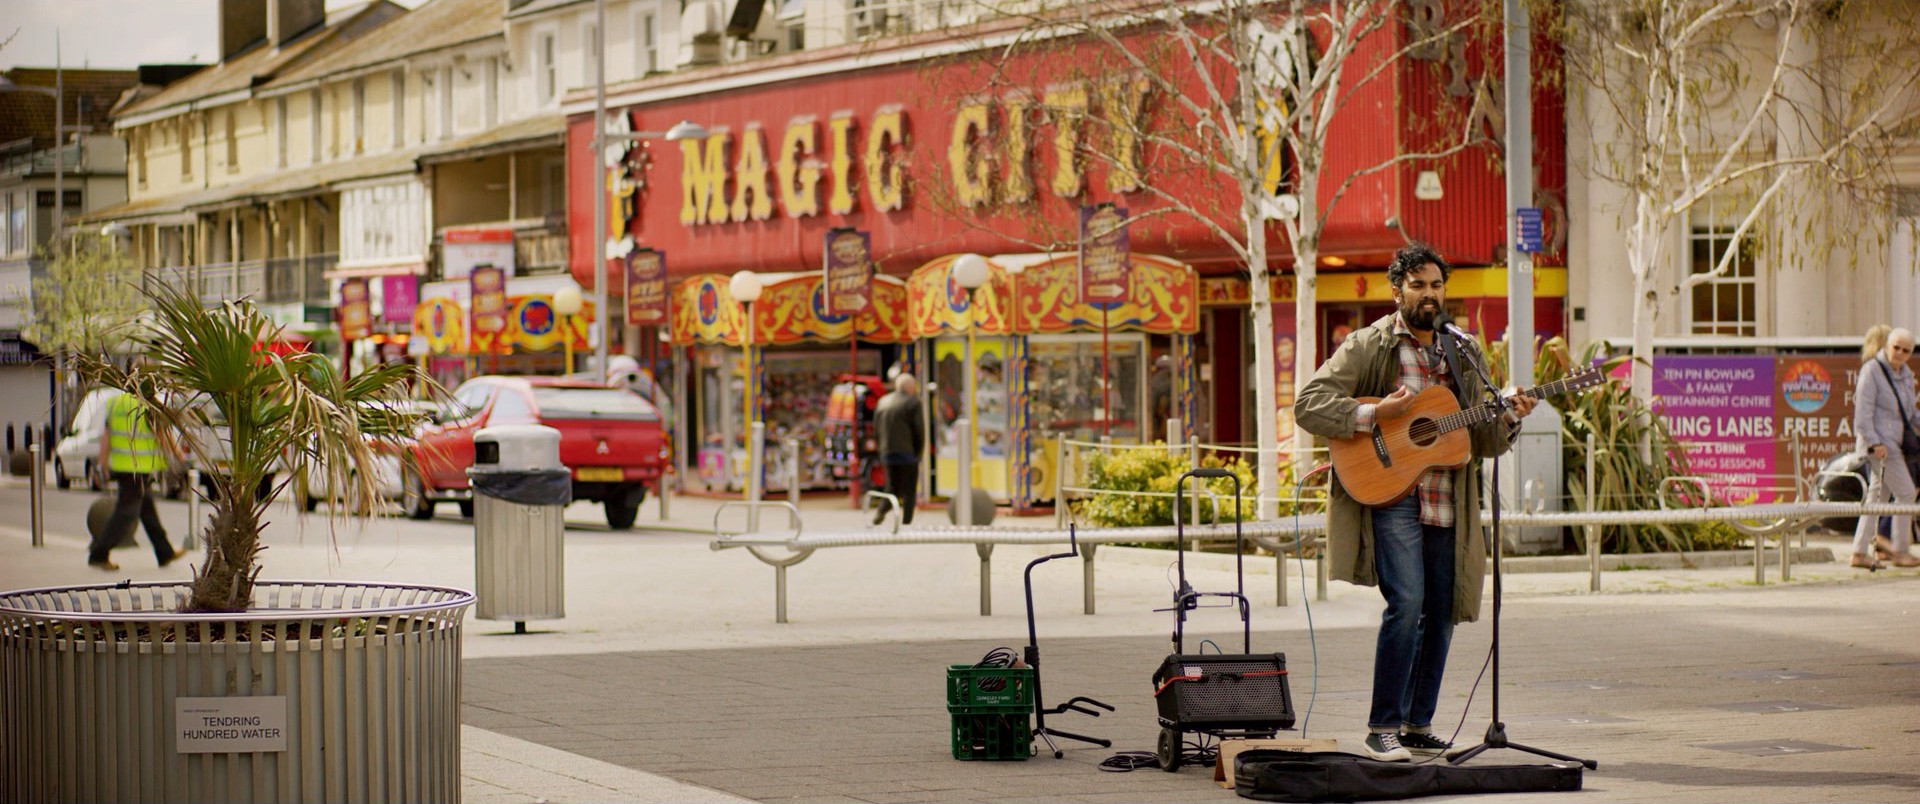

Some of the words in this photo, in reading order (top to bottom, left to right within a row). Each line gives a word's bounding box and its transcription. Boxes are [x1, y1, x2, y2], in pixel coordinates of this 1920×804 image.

[679, 104, 907, 226] MAGIC
[948, 71, 1152, 207] CITY
[1664, 368, 1683, 381] TEN
[1685, 368, 1702, 381] PIN
[1704, 368, 1755, 381] BOWLING
[1696, 383, 1734, 393] FAMILY
[1782, 381, 1831, 393] PAVILION
[1731, 395, 1771, 408] CENTRE
[1660, 416, 1712, 438] LING
[1717, 416, 1773, 438] LANES
[1784, 417, 1830, 437] FREE
[1715, 443, 1746, 454] DRINK
[1787, 442, 1808, 454] FN
[1810, 442, 1838, 454] PARK
[1719, 457, 1766, 470] SESSIONS
[202, 716, 261, 727] TENDRING
[183, 729, 239, 740] HUNDRED
[241, 728, 281, 739] WATER
